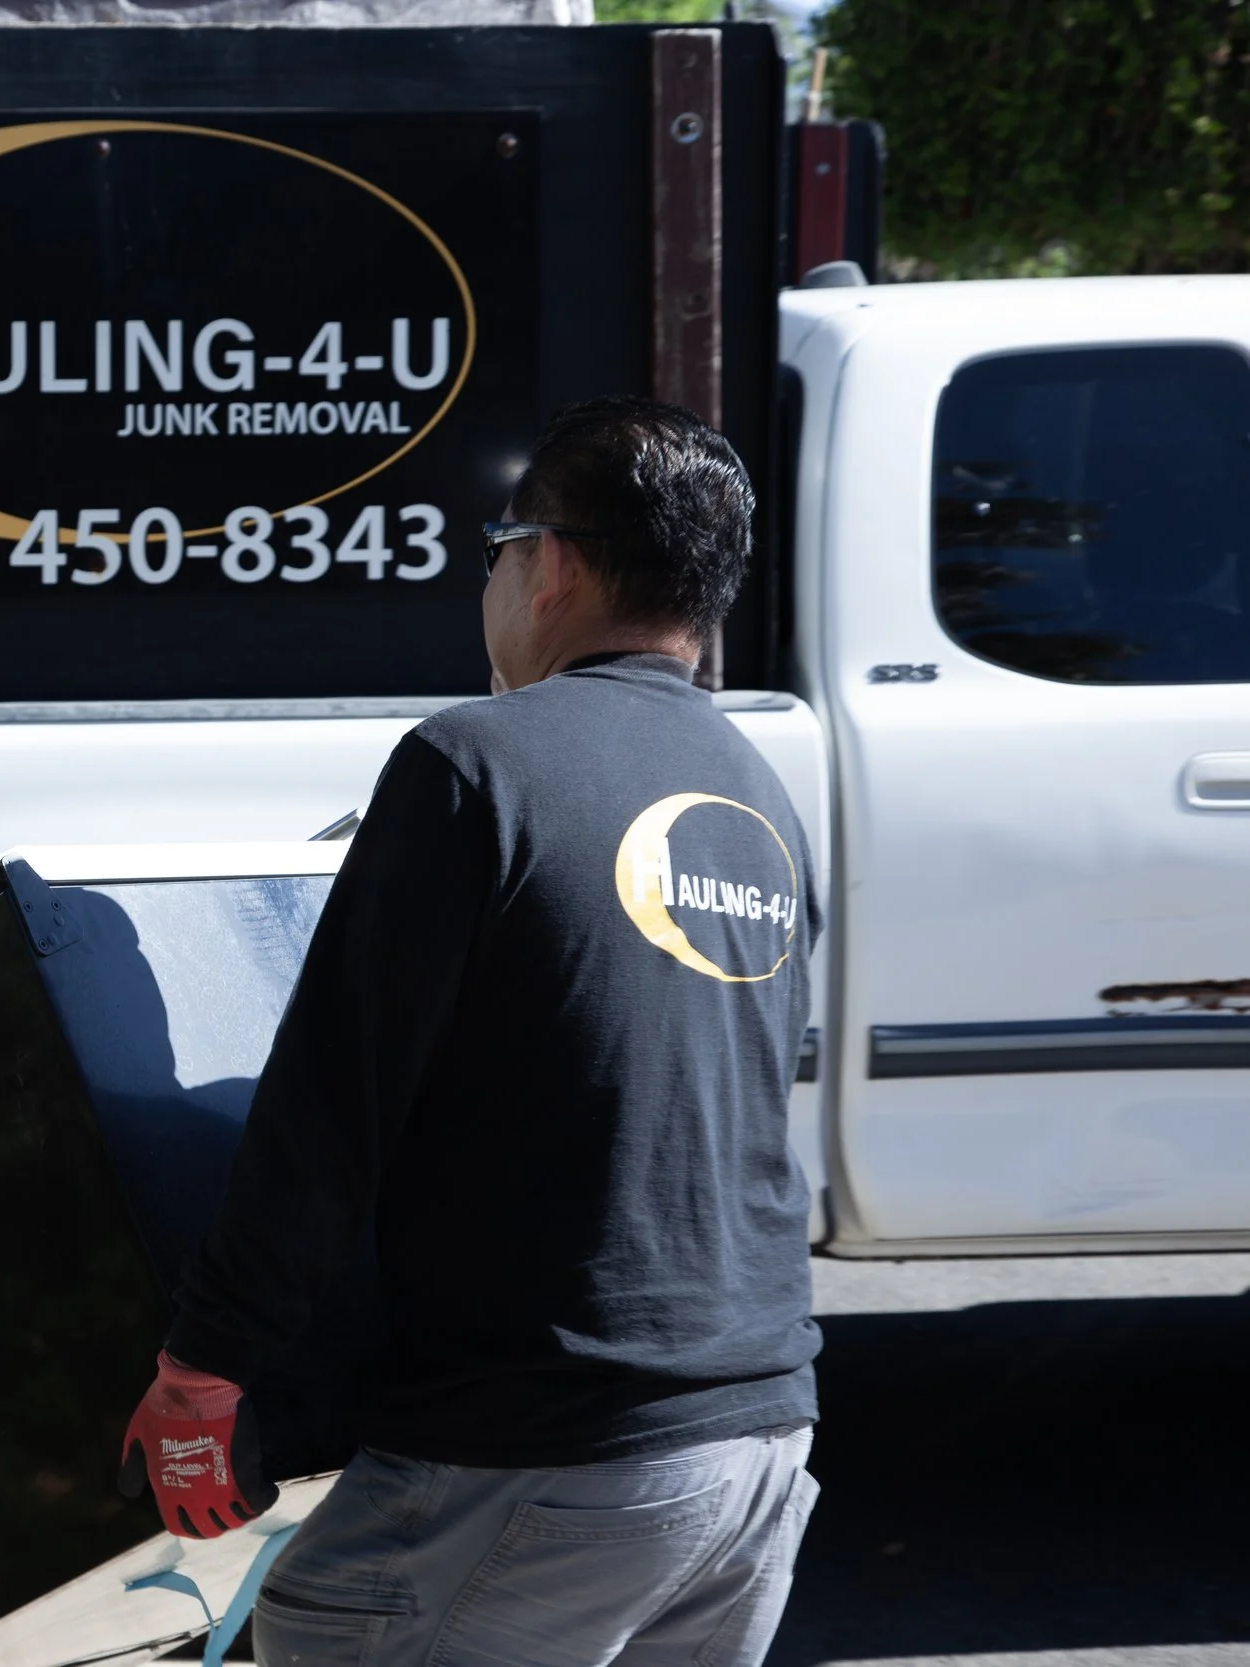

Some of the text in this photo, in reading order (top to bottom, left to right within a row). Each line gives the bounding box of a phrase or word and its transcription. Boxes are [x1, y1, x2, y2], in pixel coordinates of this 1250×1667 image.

[117, 401, 411, 437] JUNK REMOVAL
[10, 503, 447, 585] 450-8343
